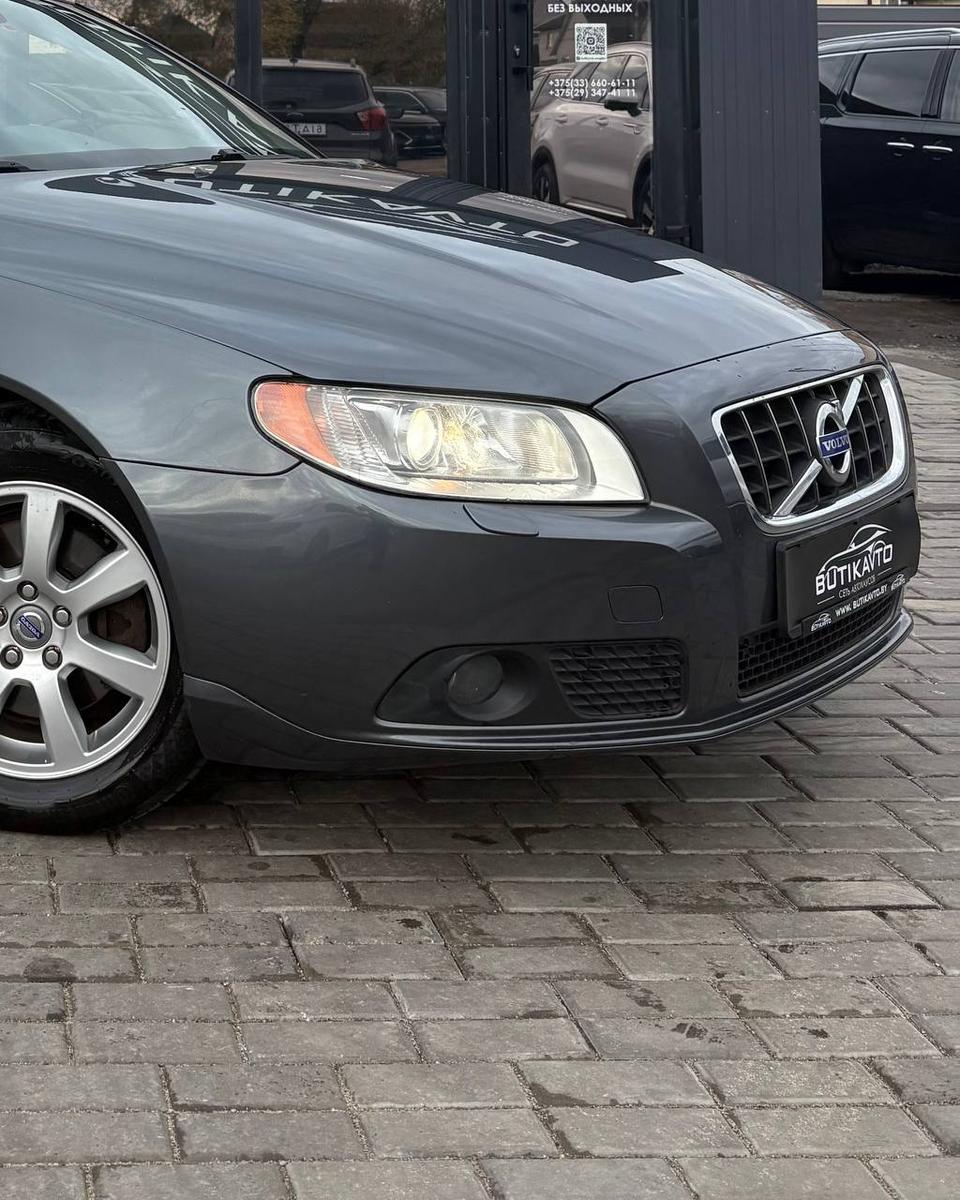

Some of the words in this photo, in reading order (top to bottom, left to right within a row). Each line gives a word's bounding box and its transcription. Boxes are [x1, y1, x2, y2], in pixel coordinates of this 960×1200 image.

[547, 3, 566, 13] БЕЗ
[568, 3, 633, 14] ВЫХОДНЫХ
[548, 78, 589, 90] +375(33)
[591, 78, 636, 87] 660-61-11
[548, 88, 589, 99] +375(29)
[591, 88, 636, 97] 347-4111
[815, 543, 893, 596] BUTIKAVTO
